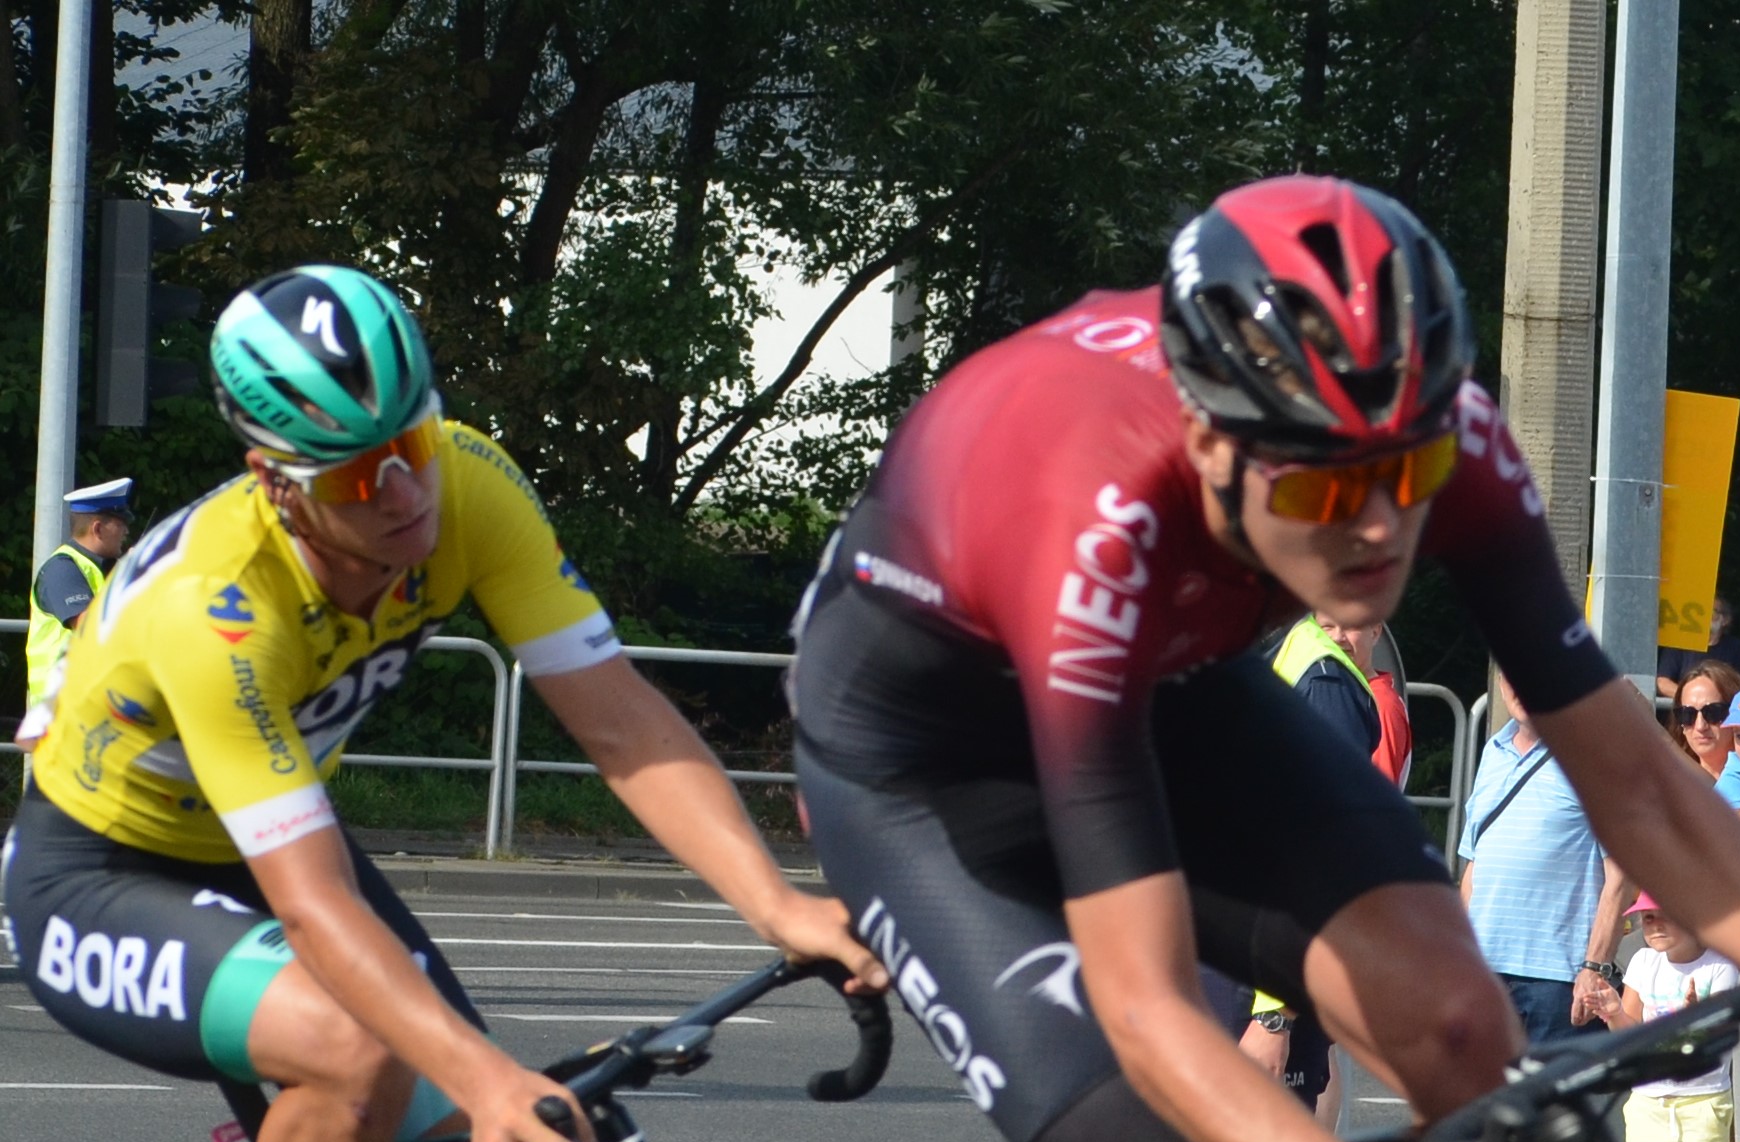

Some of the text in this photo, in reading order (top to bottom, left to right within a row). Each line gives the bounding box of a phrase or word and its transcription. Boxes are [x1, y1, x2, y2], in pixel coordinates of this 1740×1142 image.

[1048, 483, 1159, 705] INEOS
[228, 654, 298, 775] Carrefour
[37, 914, 188, 1022] BORA
[857, 897, 1006, 1113] INEOS
[1283, 1071, 1305, 1088] CJA
